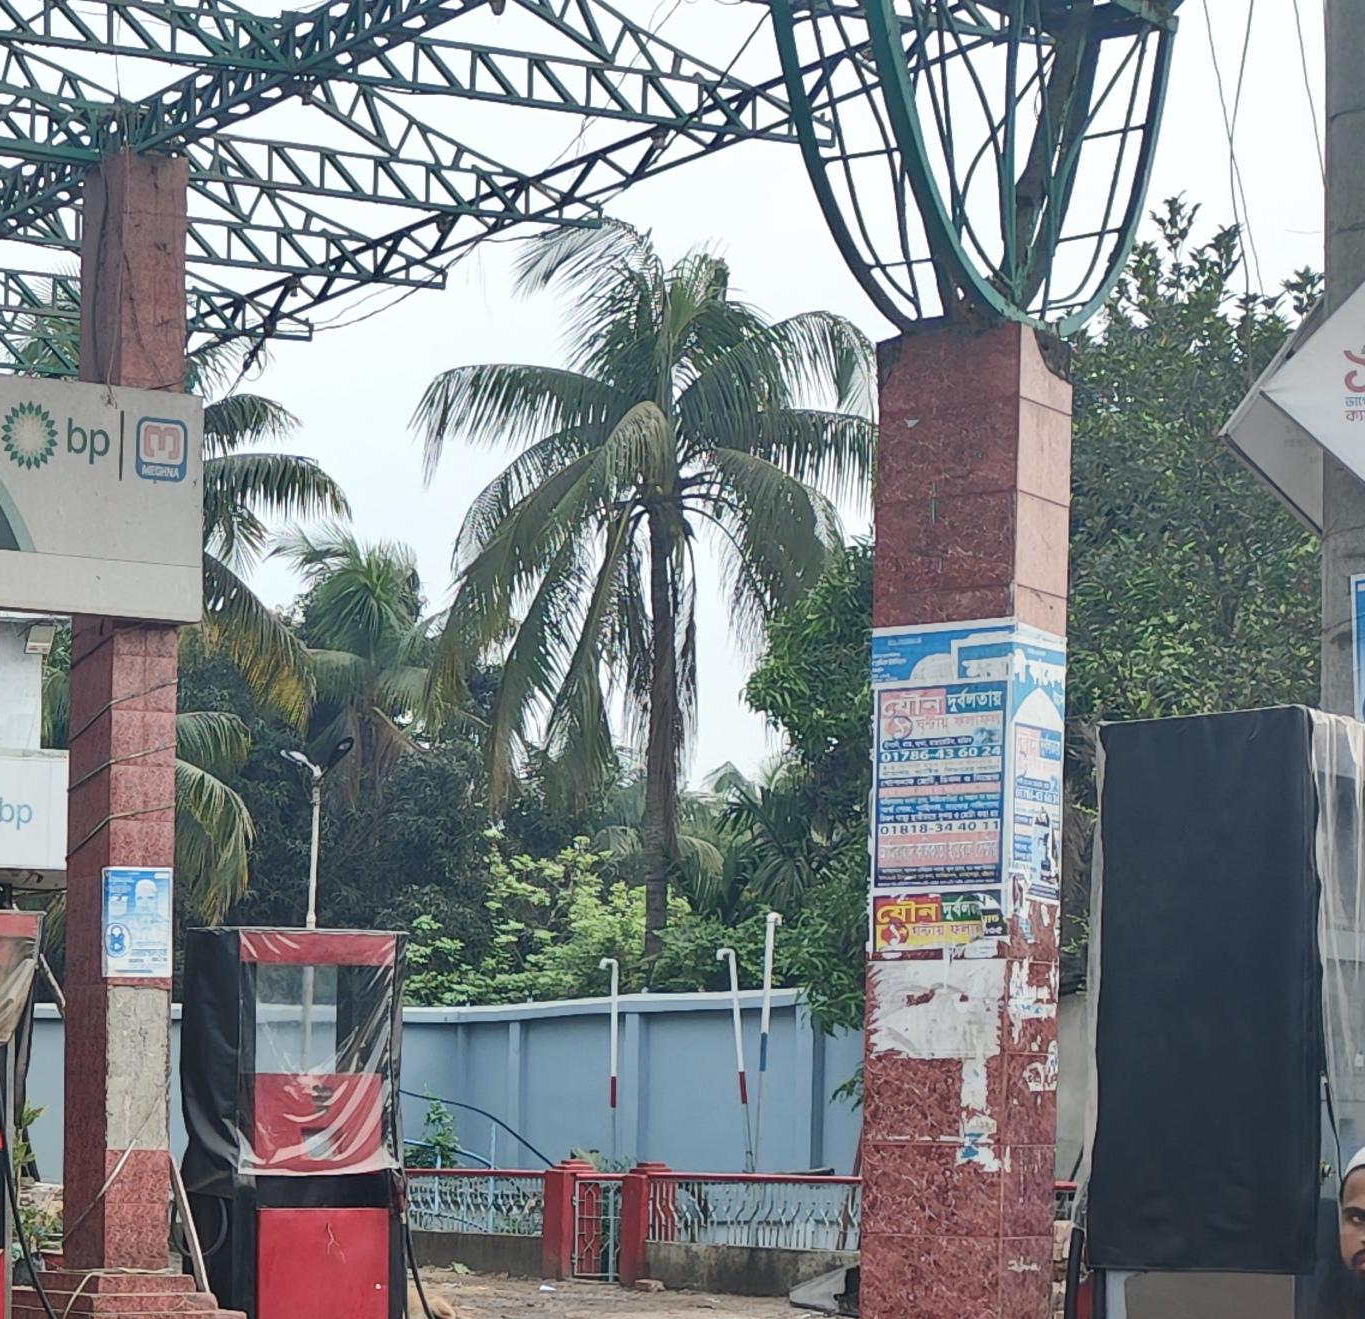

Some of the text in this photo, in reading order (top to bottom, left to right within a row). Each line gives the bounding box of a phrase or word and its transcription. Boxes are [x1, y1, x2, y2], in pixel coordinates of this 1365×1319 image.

[67, 417, 111, 465] bp
[141, 463, 180, 479] MEGHNA
[881, 746, 1001, 762] 01786-43 60 24
[880, 821, 999, 835] 01818-34 40 11
